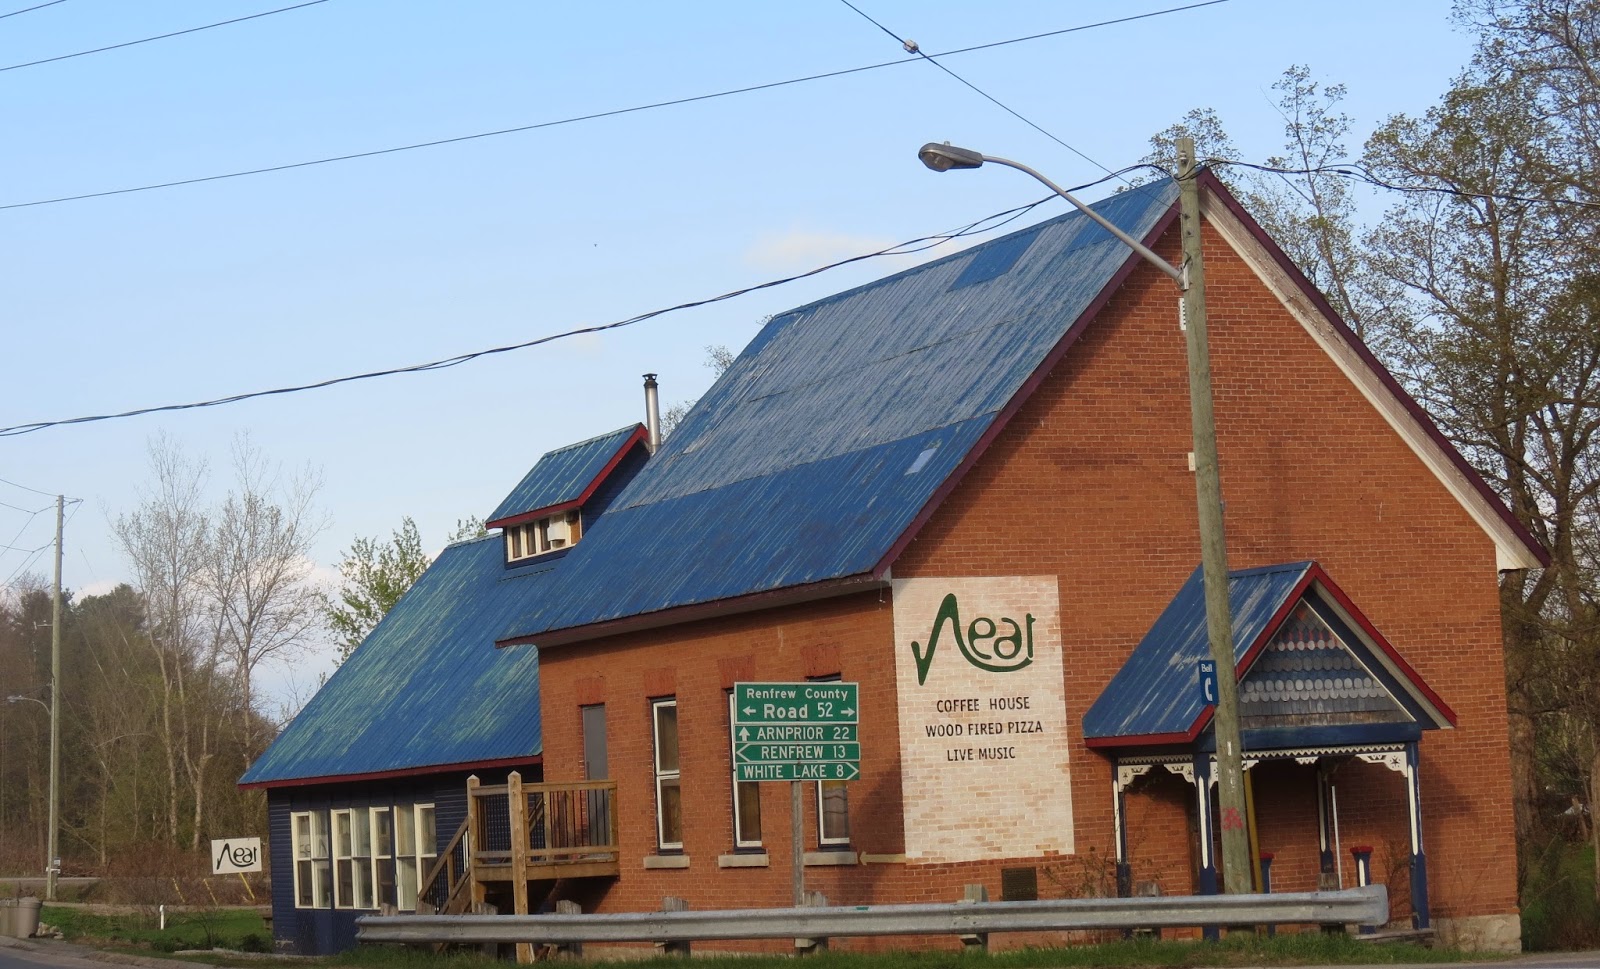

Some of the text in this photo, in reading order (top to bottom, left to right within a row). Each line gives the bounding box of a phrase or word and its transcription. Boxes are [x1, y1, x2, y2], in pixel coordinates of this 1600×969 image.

[1201, 664, 1212, 672] Bell
[746, 688, 848, 701] Renfrew County
[764, 702, 834, 718] Road 52
[936, 697, 1030, 712] COFFEE HOUSE
[757, 727, 850, 740] ARNPRIOR 22
[926, 721, 1043, 737] WOOD FIRED PIZZA
[762, 745, 846, 758] RENFREW 13
[947, 747, 1016, 761] LIVE MUSIC
[744, 765, 844, 778] WHITE LAKE 8
